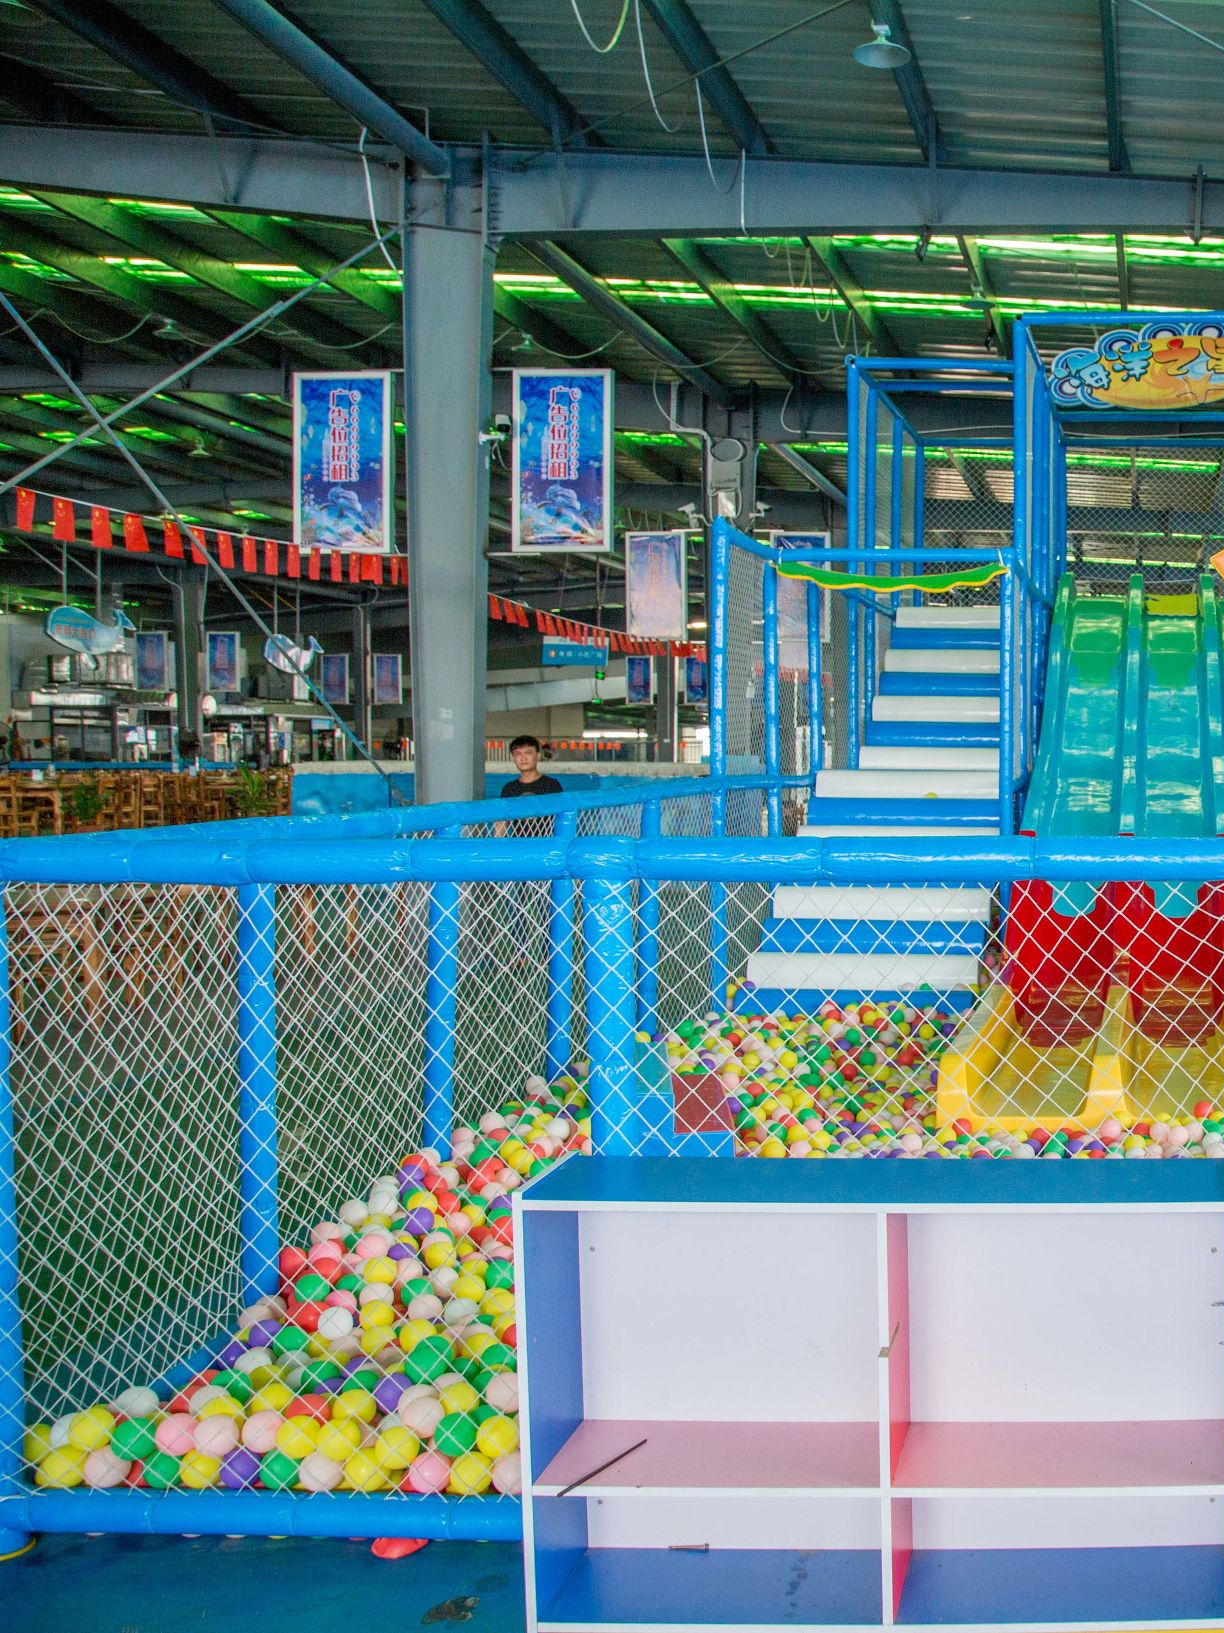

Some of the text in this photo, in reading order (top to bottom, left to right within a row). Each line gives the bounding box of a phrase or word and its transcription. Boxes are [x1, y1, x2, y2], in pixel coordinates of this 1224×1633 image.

[330, 388, 349, 481] 广告位招租
[549, 386, 568, 479] 广告位招租
